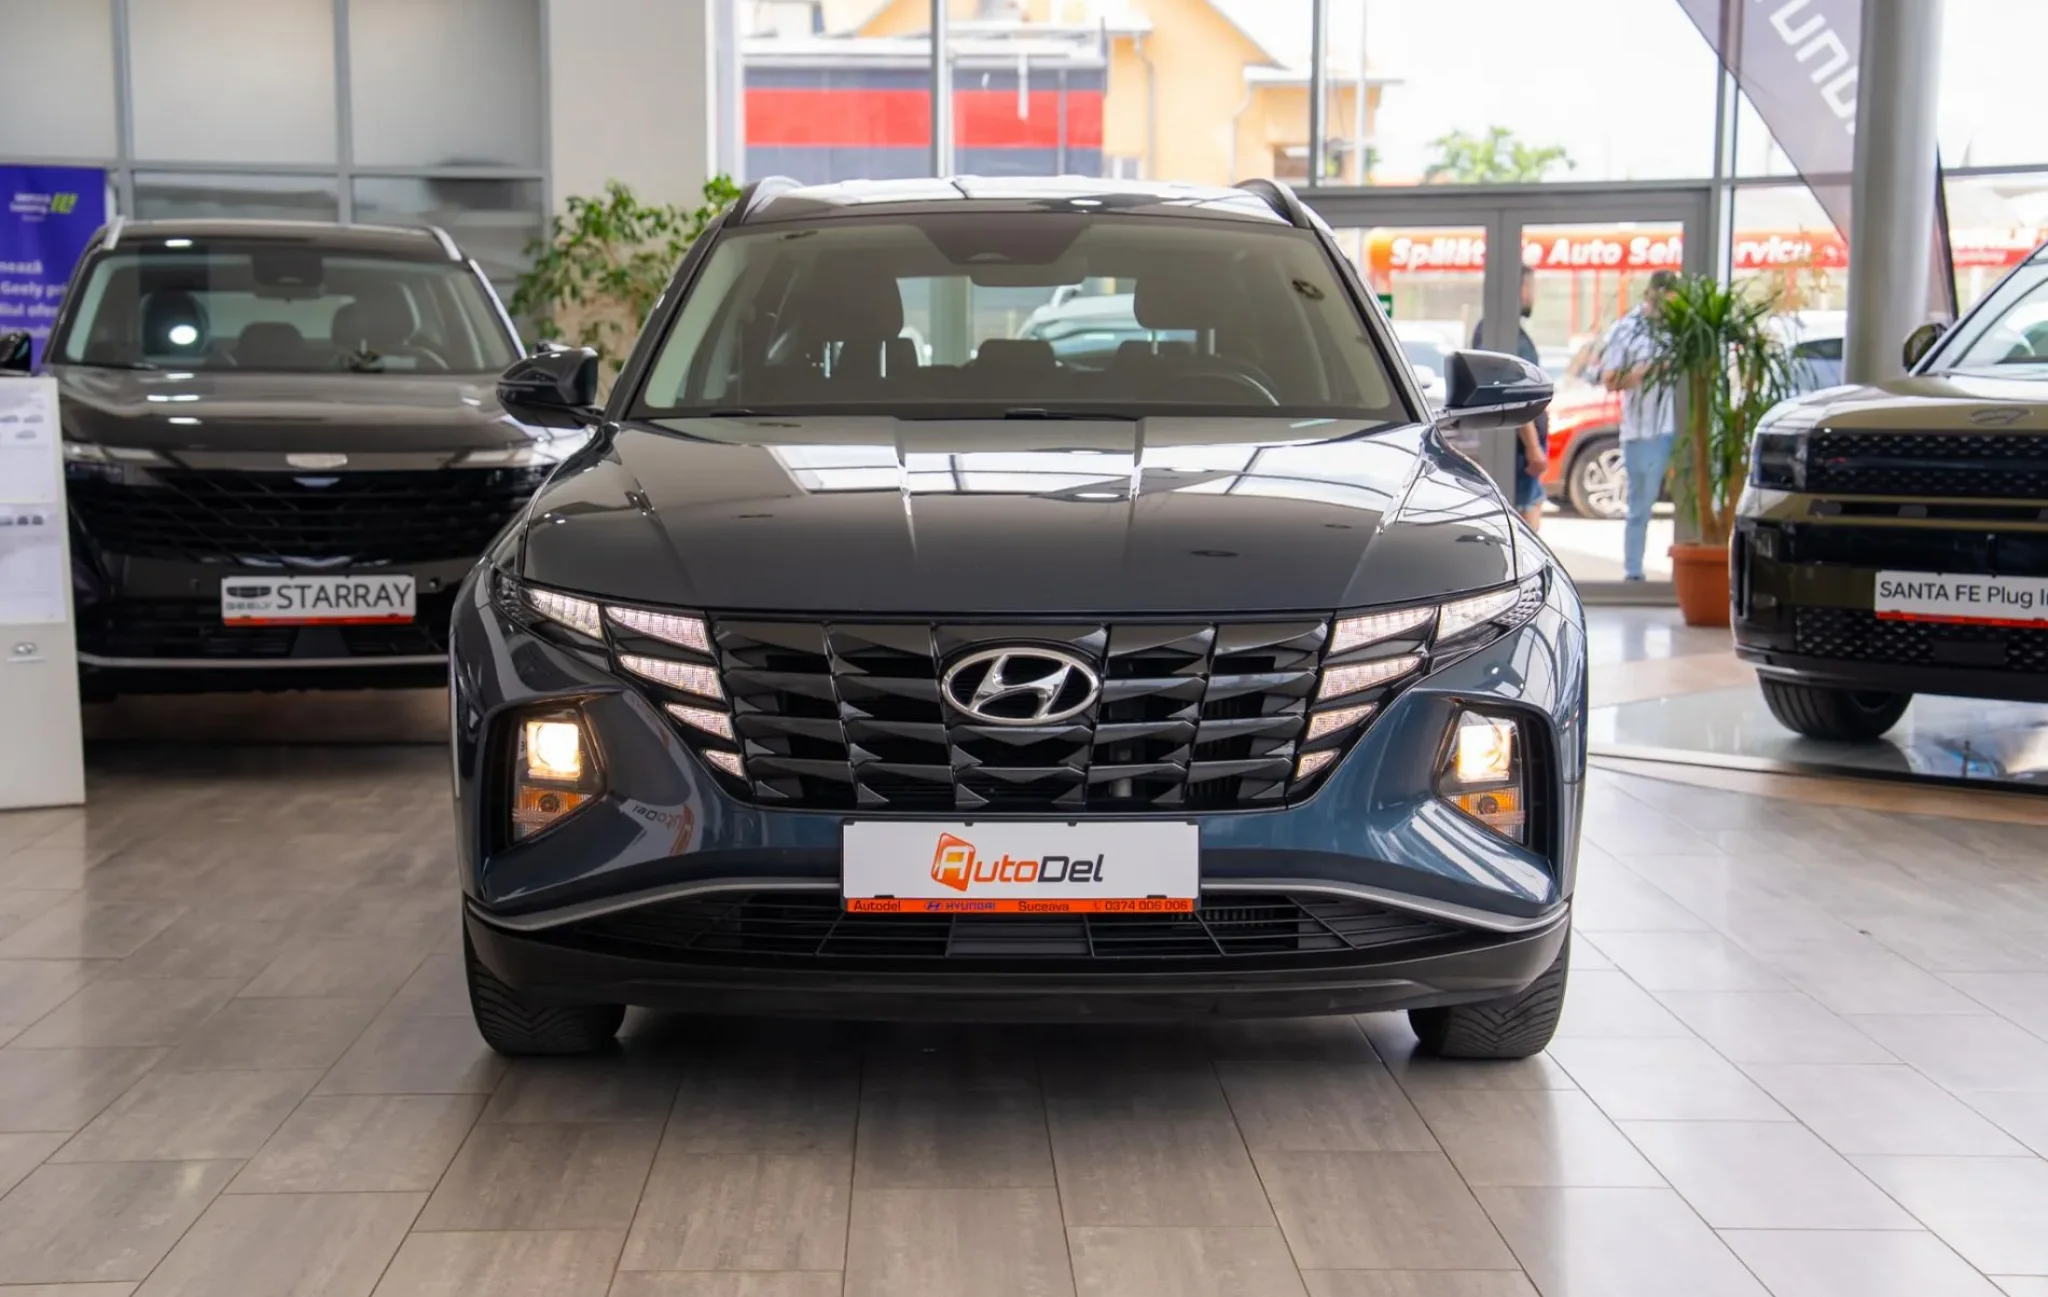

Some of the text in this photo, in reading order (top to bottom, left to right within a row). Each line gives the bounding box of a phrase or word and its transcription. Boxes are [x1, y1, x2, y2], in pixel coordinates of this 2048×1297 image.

[1547, 238, 1622, 266] Auto
[276, 583, 411, 609] STARRAY
[1880, 581, 1949, 601] SANTA
[1955, 584, 1981, 602] FE
[1987, 586, 2034, 609] Plug
[933, 840, 1104, 888] AutoDel
[854, 901, 1188, 912] Autodel HYUNDAI Suceava 0374 006 006
